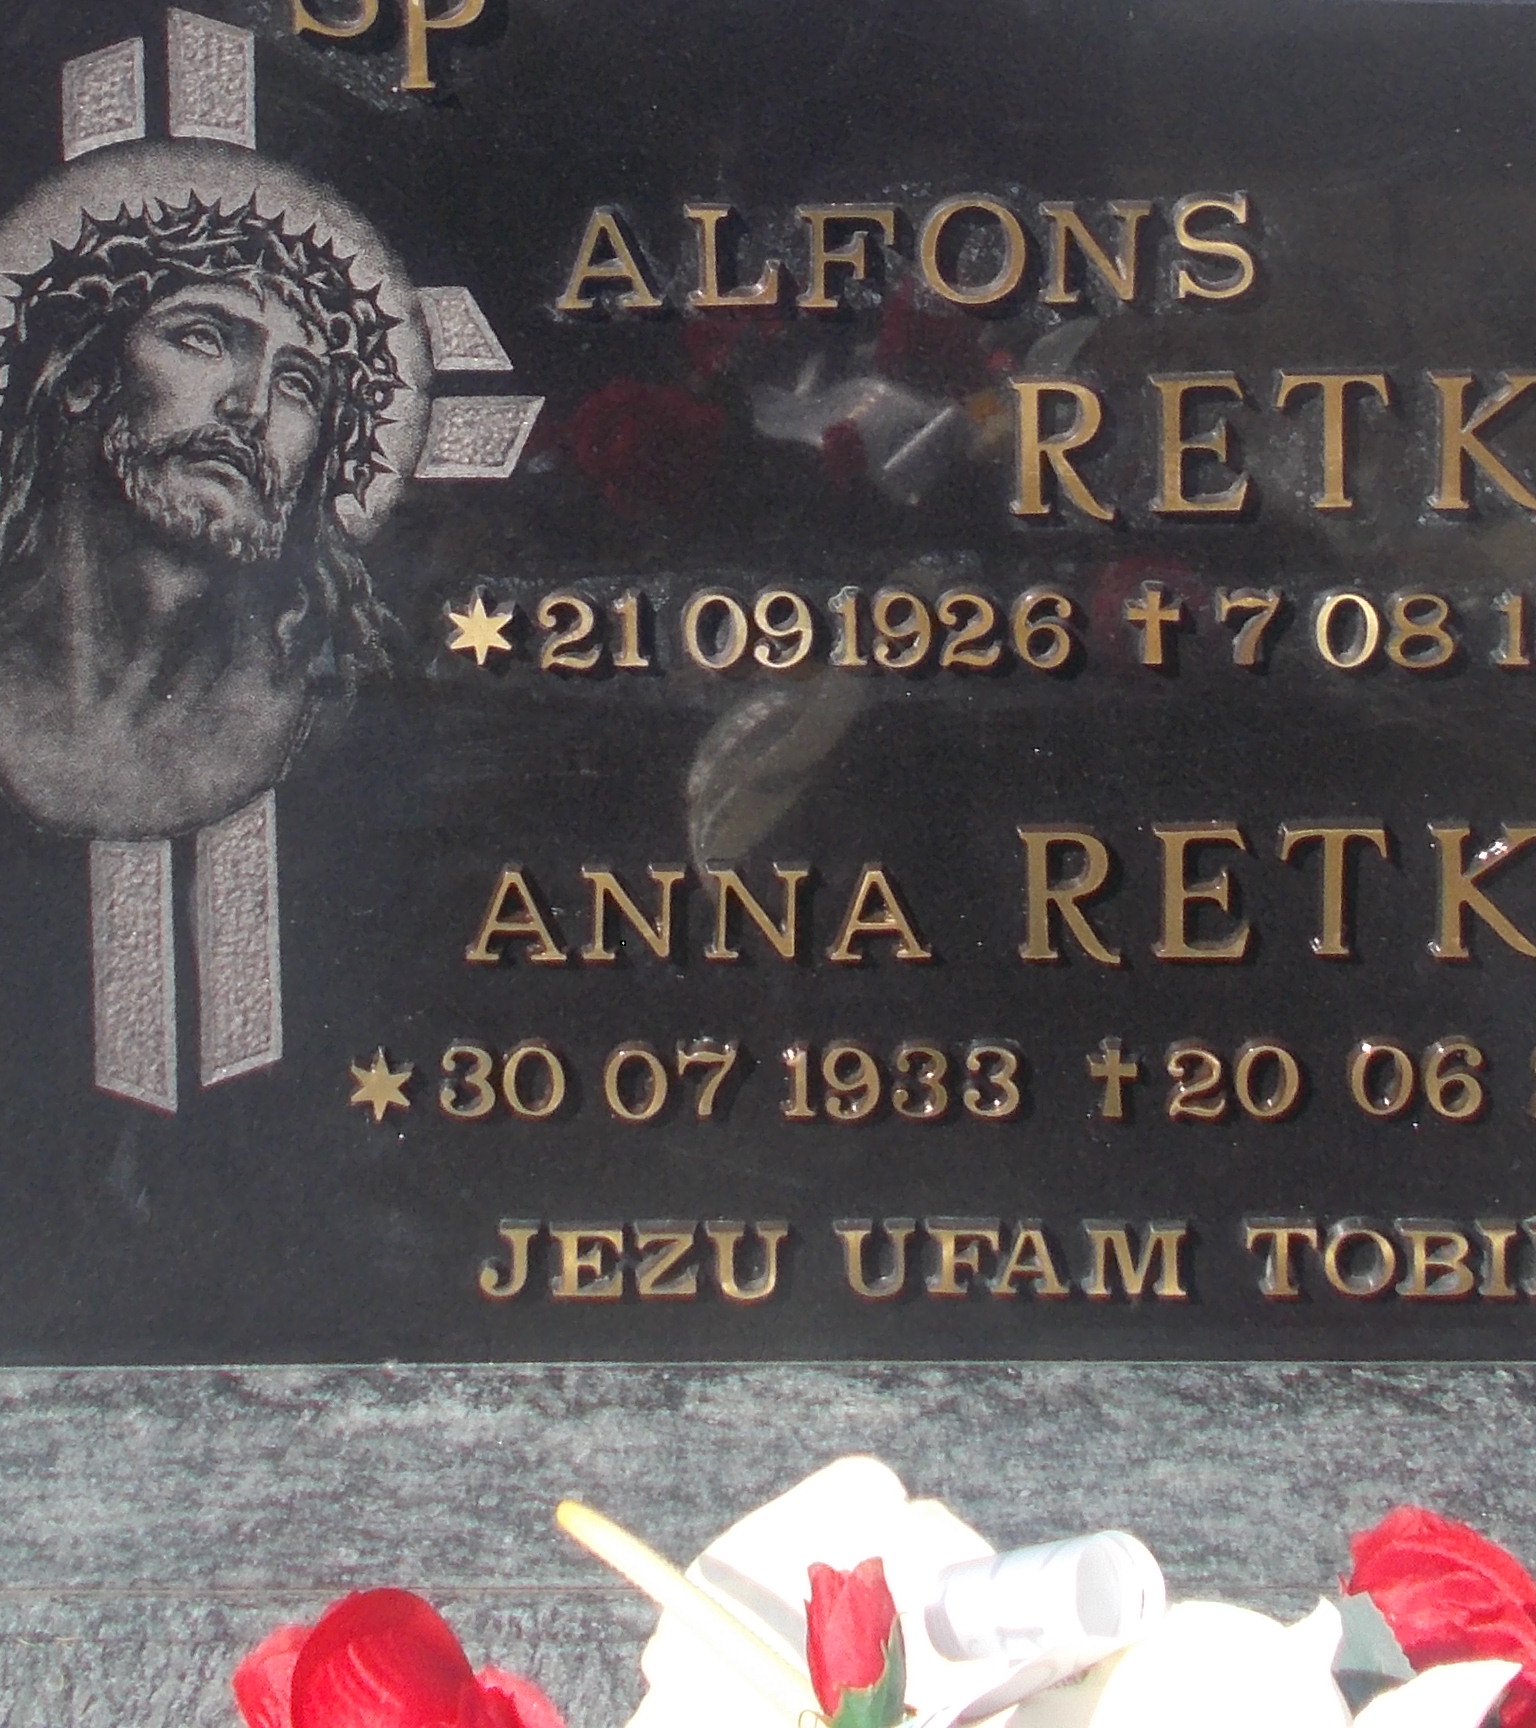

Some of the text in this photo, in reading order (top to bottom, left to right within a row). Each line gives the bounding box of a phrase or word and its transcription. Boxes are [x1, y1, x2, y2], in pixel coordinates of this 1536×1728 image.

[555, 192, 1256, 310] ALFONS
[1217, 587, 1282, 667] 7
[1314, 587, 1457, 669] 08
[464, 862, 933, 962] ANNA
[438, 1039, 566, 1120] 30
[603, 1036, 738, 1121] 07
[778, 1038, 1022, 1121] 1933
[1165, 1038, 1302, 1121] 20
[1348, 1035, 1485, 1121] 06
[479, 1216, 790, 1301] JEZU
[832, 1216, 1189, 1300] UFAM
